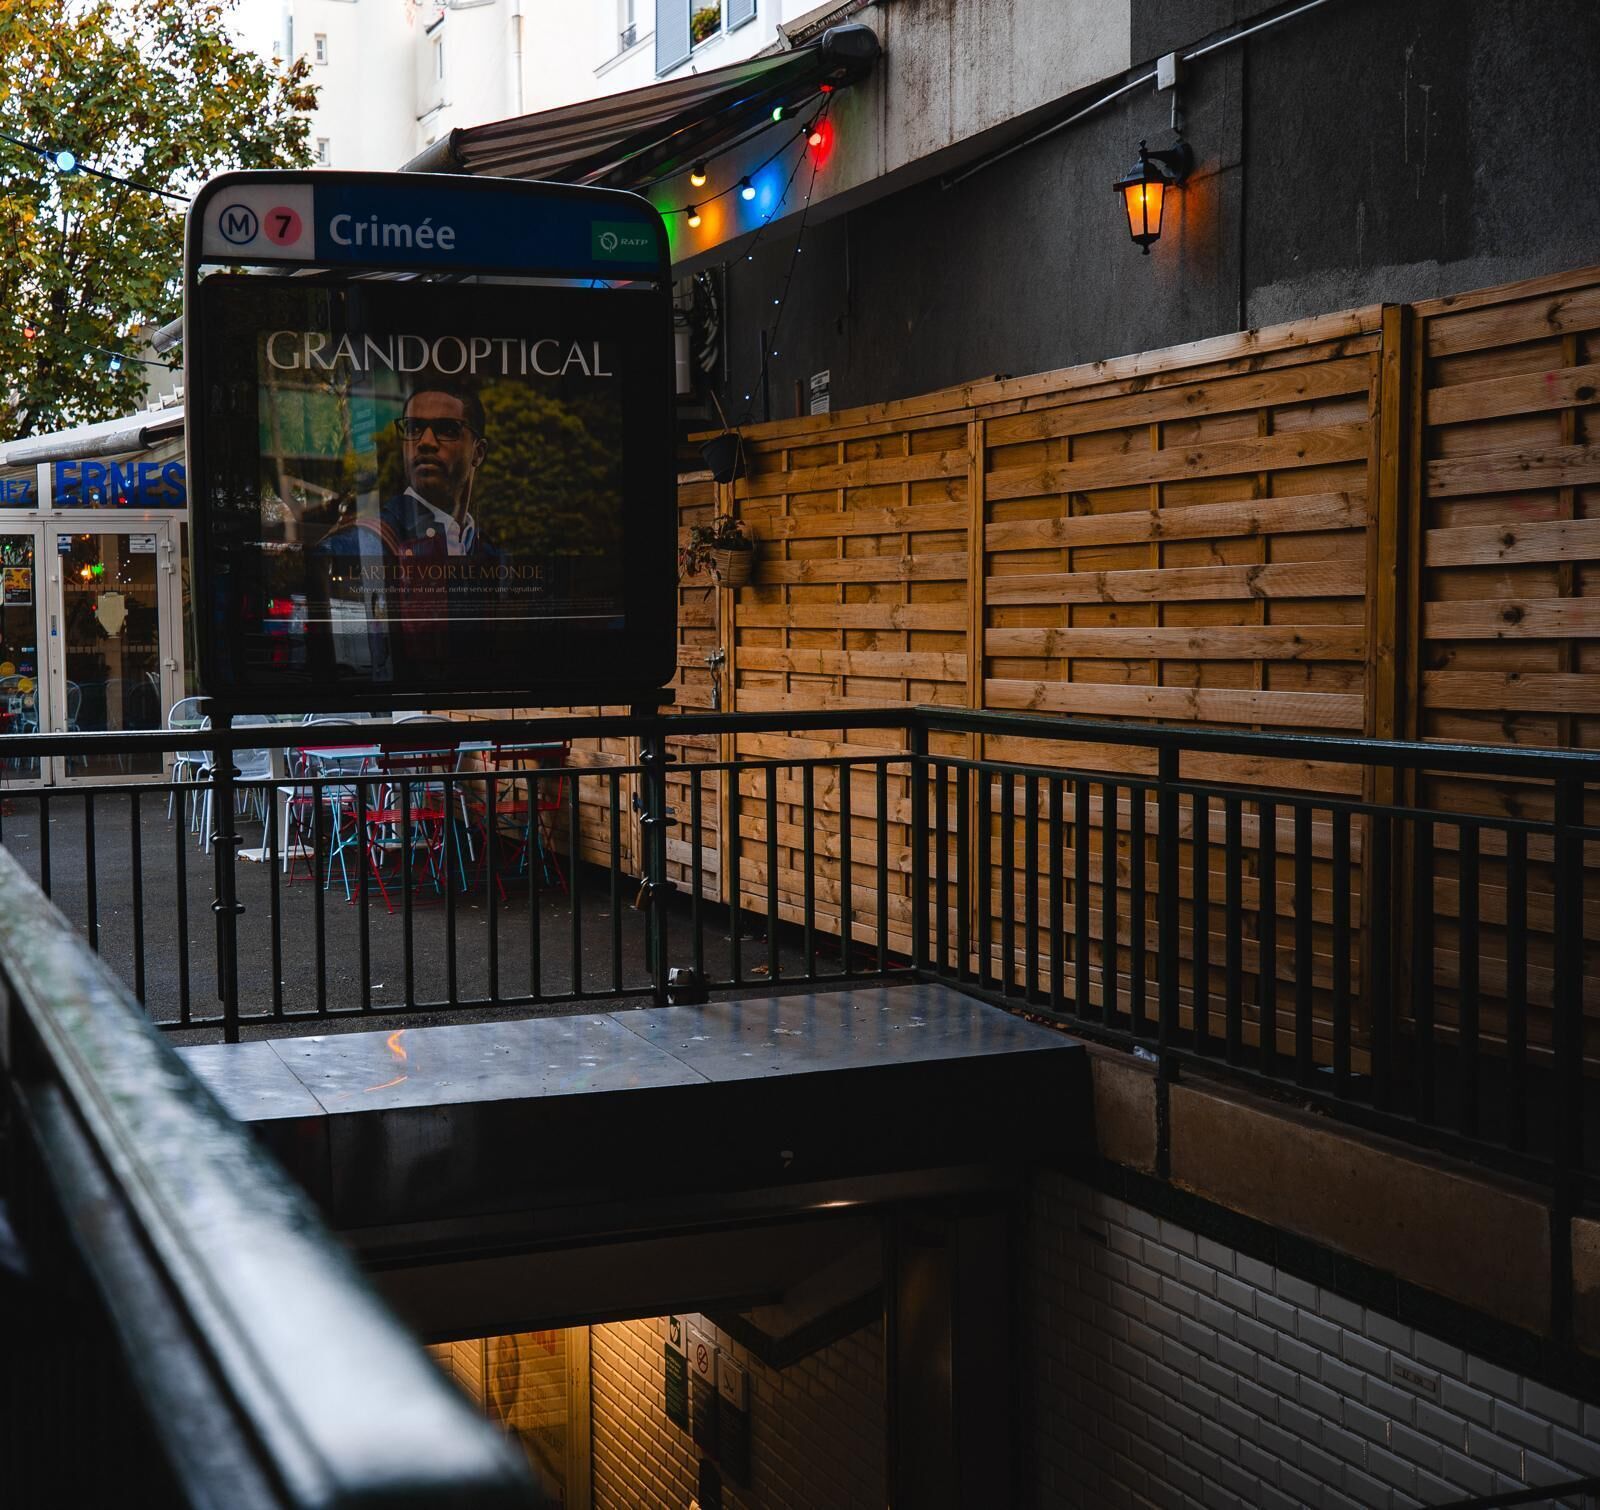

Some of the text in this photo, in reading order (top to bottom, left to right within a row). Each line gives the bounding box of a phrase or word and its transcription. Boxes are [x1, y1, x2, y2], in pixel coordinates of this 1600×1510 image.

[275, 215, 292, 238] 7
[329, 213, 456, 250] Crimée
[620, 238, 649, 246] RATP
[265, 329, 614, 378] GRANDOPTICAL
[0, 480, 31, 503] EZ
[348, 564, 545, 580] L'ART DE VOIR LE MONDE
